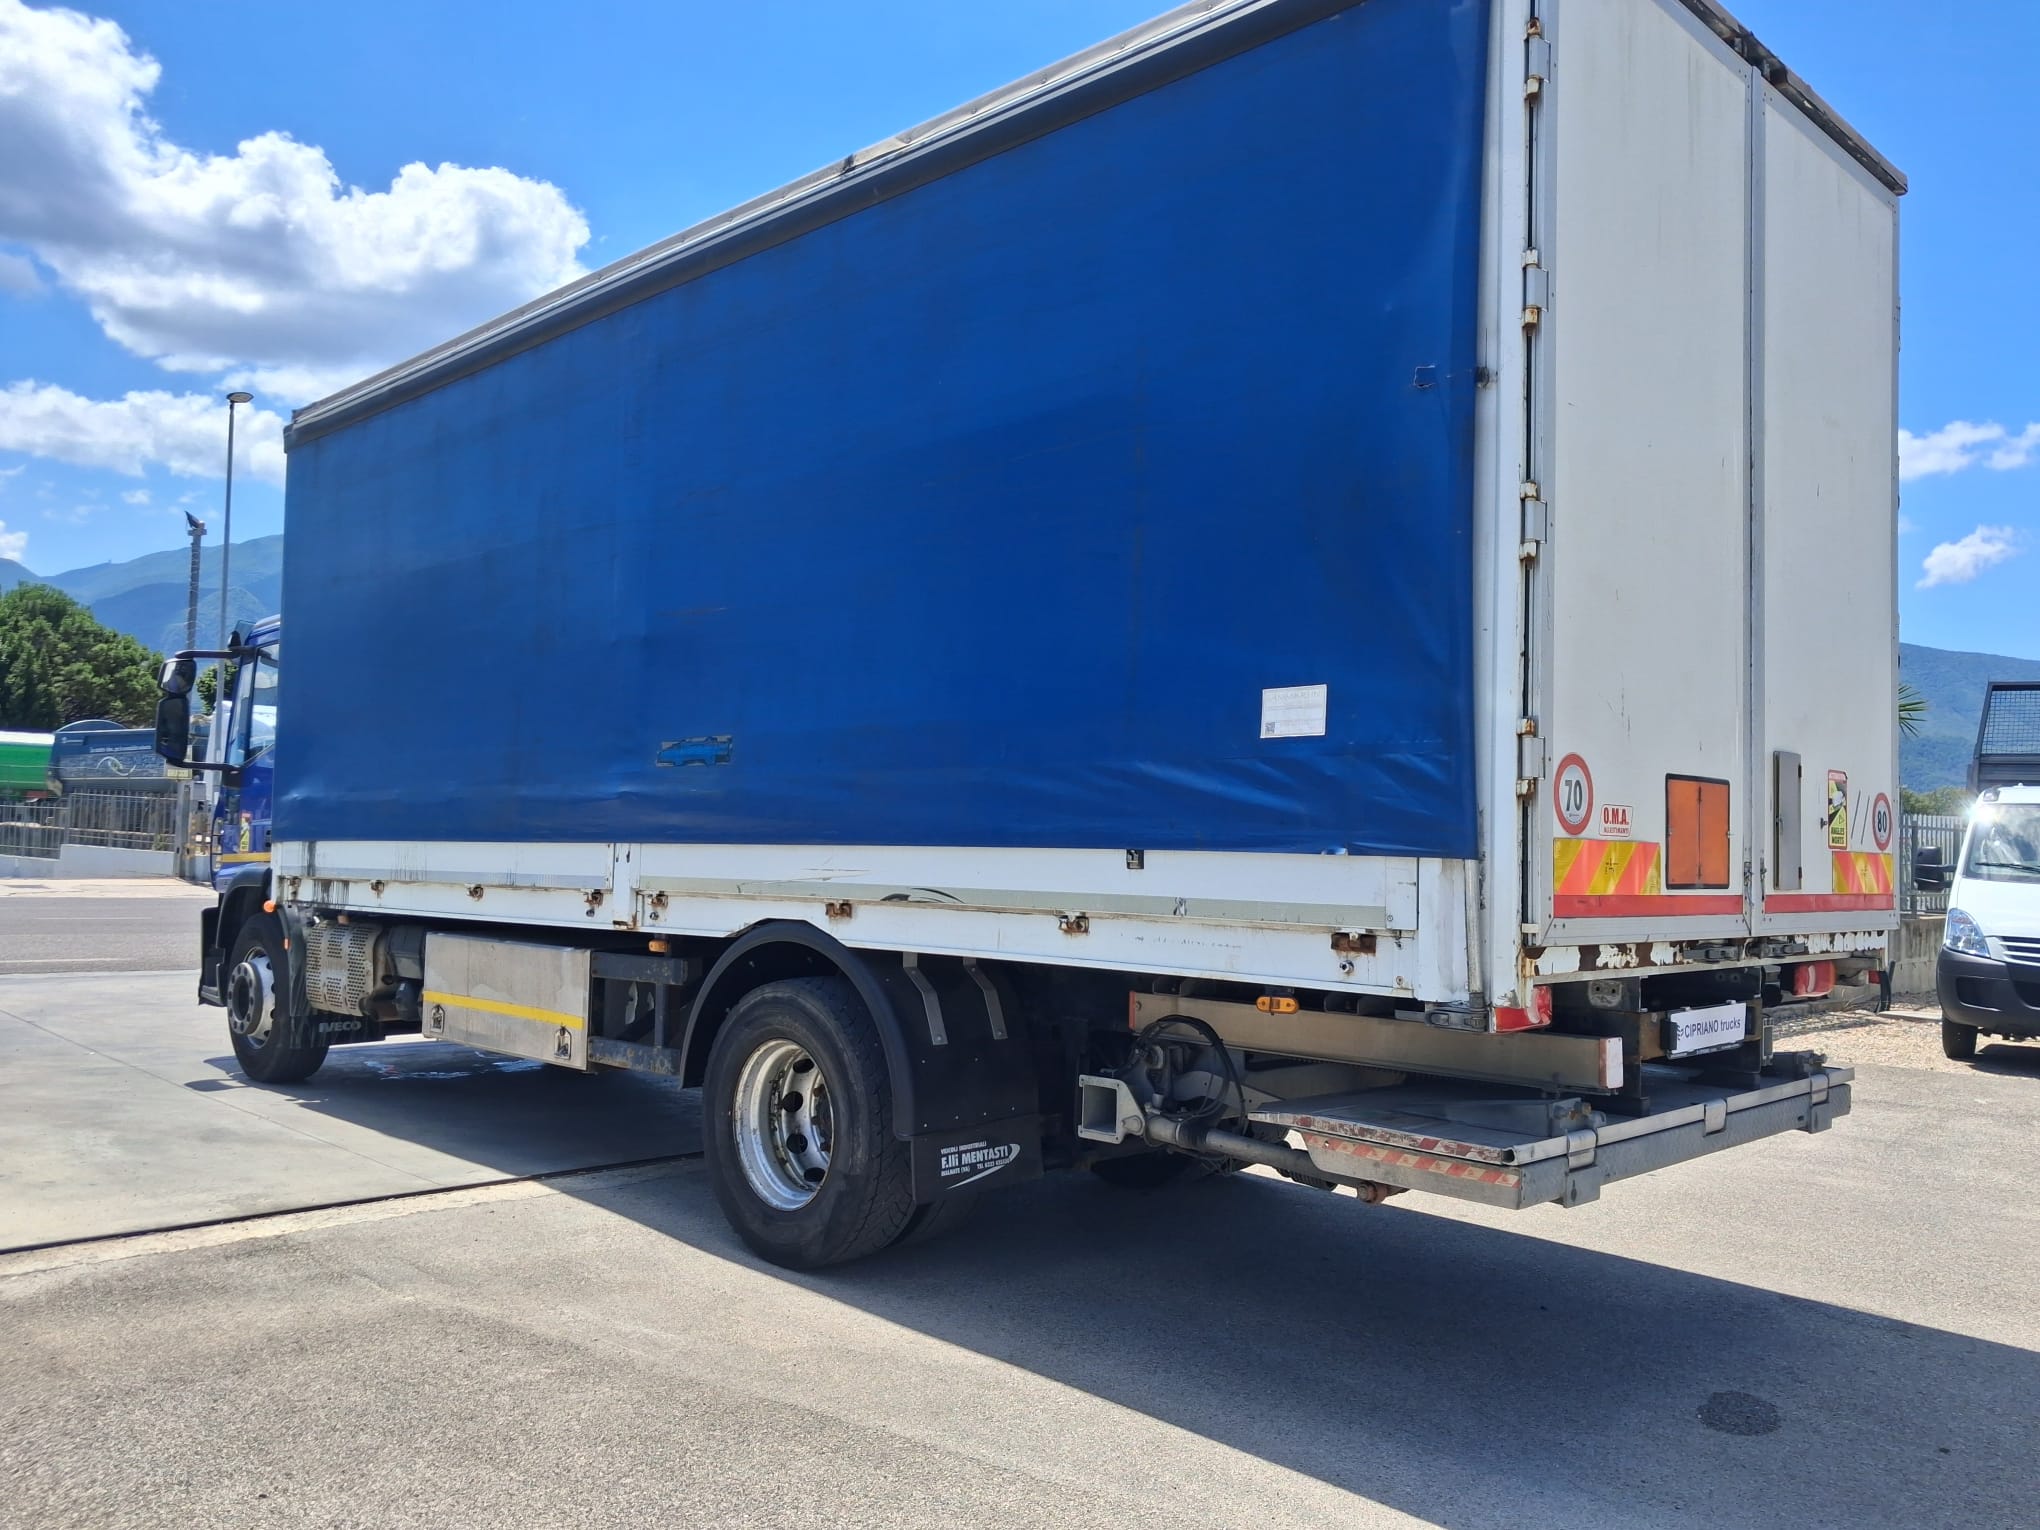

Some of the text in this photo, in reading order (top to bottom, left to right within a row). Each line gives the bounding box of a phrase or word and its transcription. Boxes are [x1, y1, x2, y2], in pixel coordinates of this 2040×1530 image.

[1565, 780, 1583, 811] 70
[1603, 807, 1630, 825] O.M.A.
[1878, 811, 1888, 832] 80
[319, 1021, 361, 1032] IVECO
[1684, 1017, 1741, 1038] CIPRIANO trucks
[961, 1145, 1009, 1166] MENTASTI
